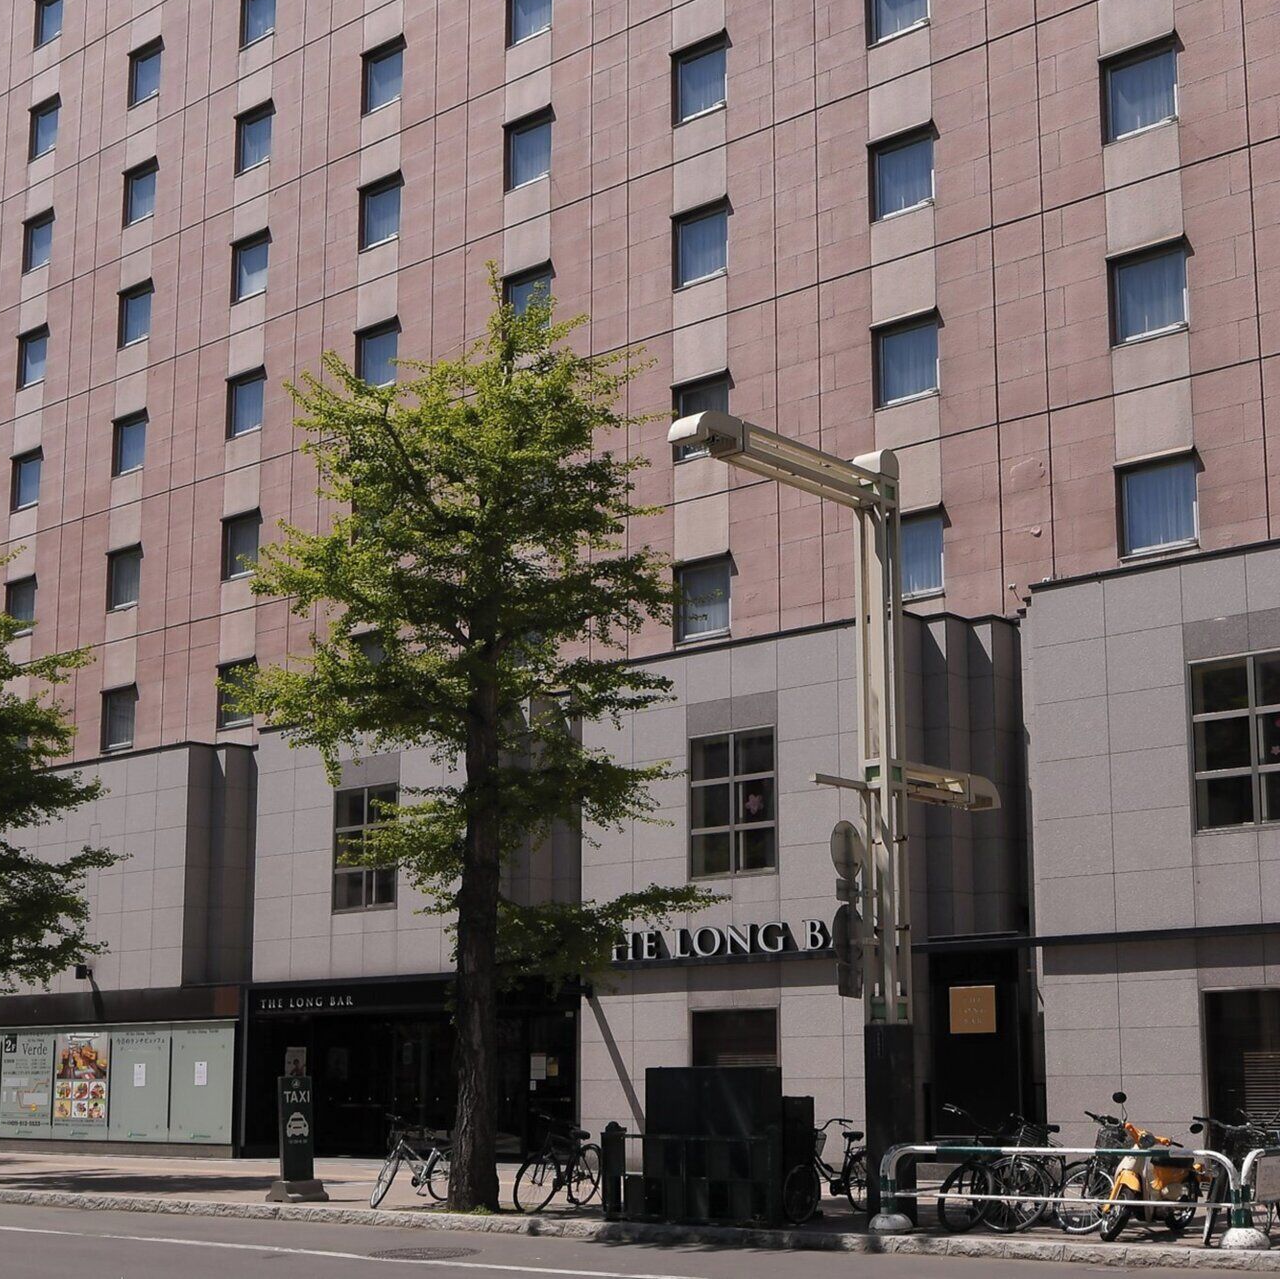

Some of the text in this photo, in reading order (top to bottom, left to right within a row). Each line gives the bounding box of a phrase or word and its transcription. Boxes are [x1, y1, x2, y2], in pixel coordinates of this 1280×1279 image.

[611, 931, 658, 961] HE
[671, 922, 787, 958] LONG
[260, 995, 354, 1009] THE LONG BAR
[21, 1043, 48, 1056] Verde
[283, 1090, 310, 1103] TAXI
